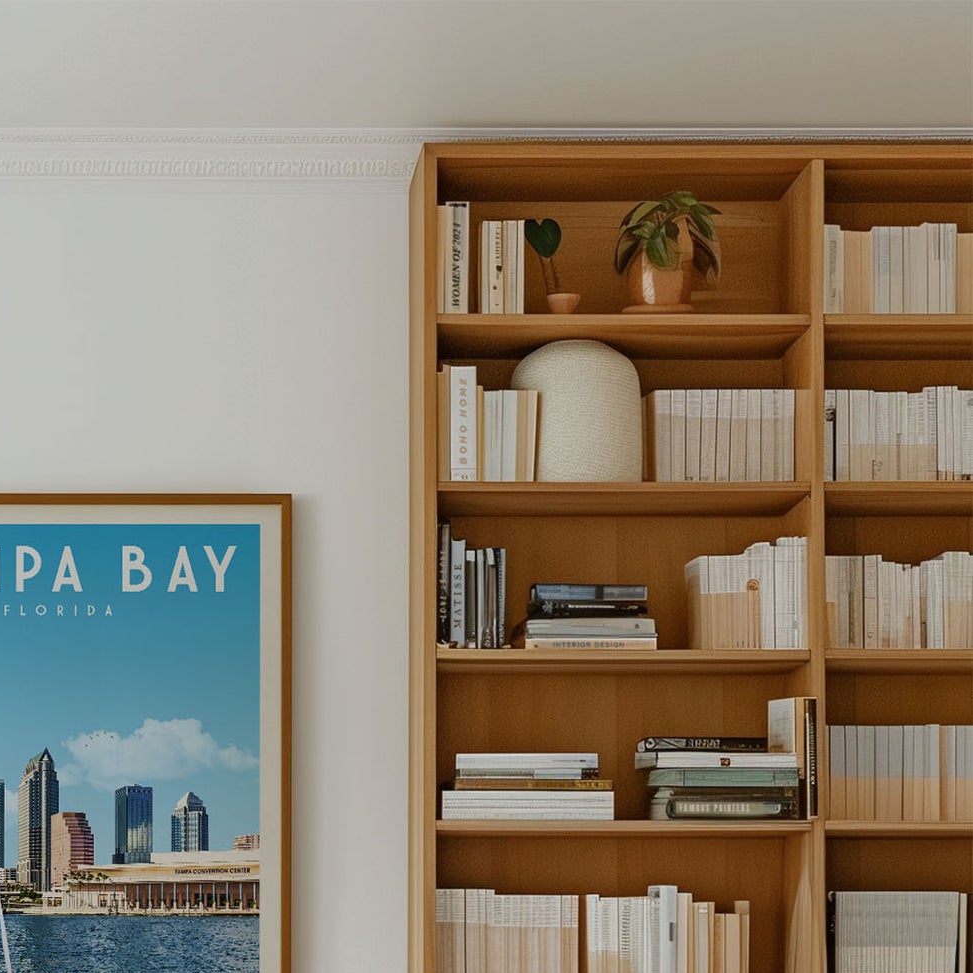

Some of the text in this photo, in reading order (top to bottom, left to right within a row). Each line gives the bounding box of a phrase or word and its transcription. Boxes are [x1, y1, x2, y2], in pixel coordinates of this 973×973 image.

[452, 247, 461, 262] OF
[452, 264, 461, 307] WOMEN
[459, 377, 468, 465] BOHO HOME
[122, 545, 237, 592] BAY
[4, 605, 113, 616] FLORIDA
[453, 563, 462, 629] MATISSE
